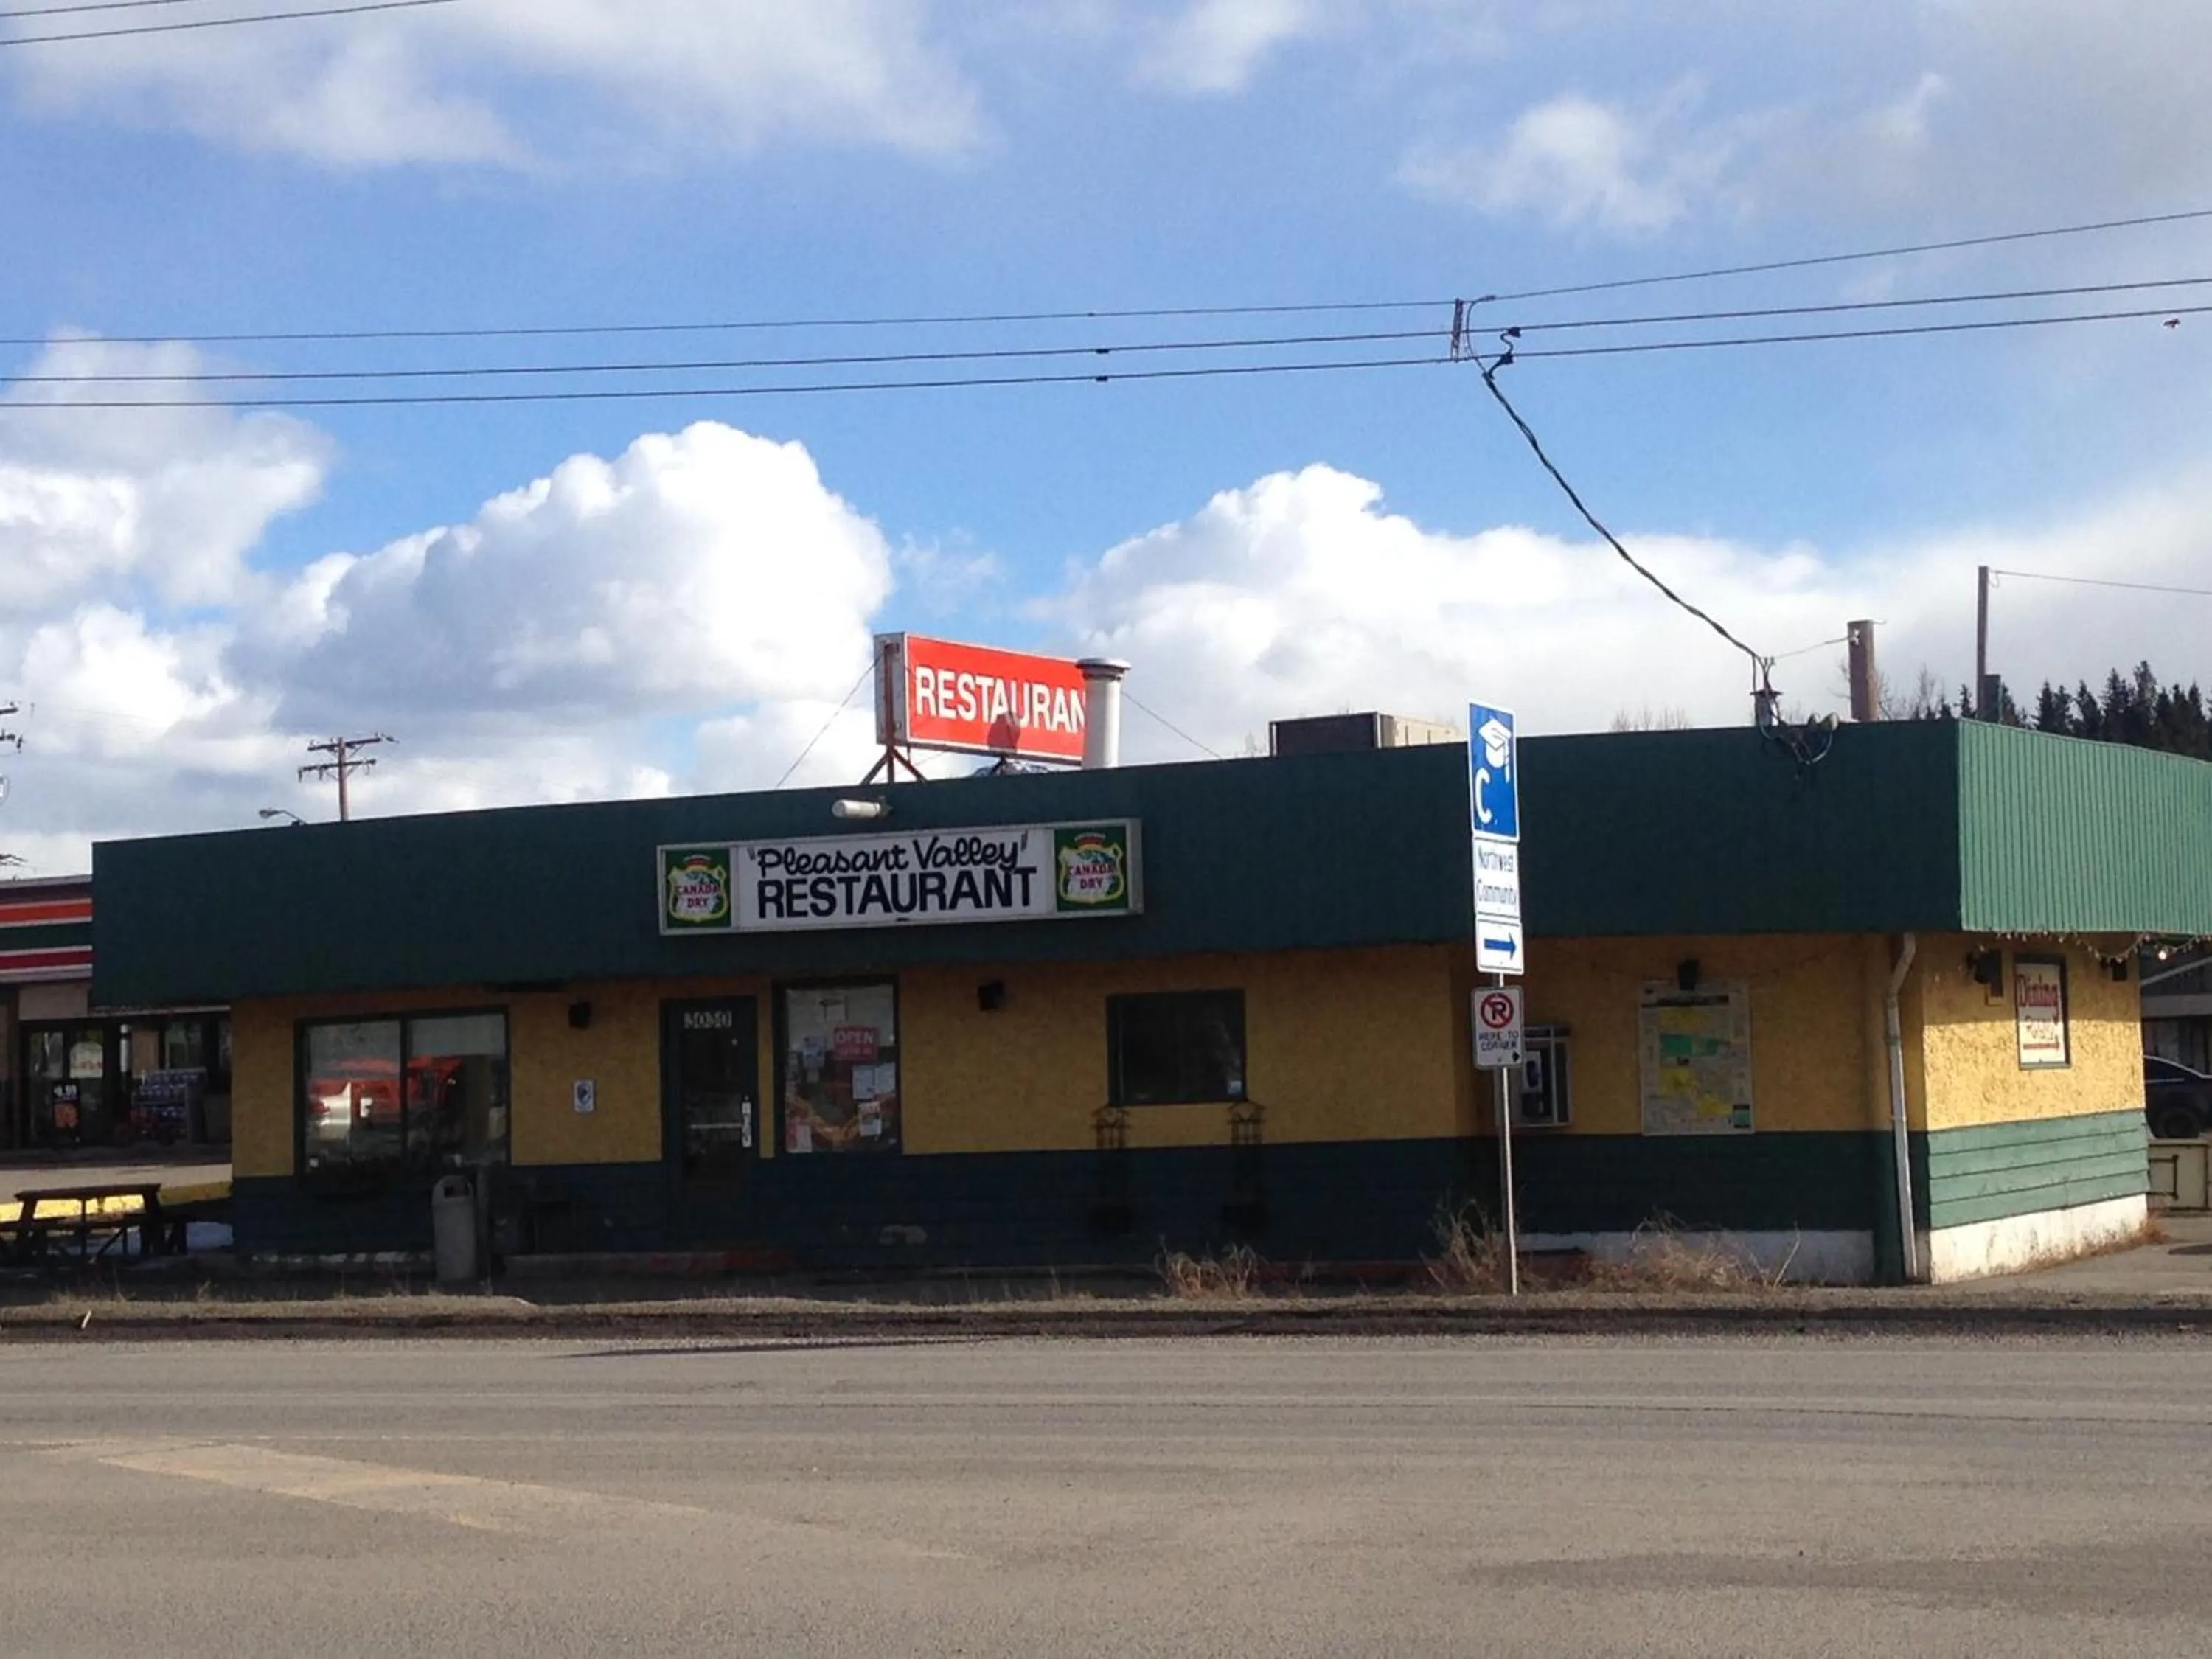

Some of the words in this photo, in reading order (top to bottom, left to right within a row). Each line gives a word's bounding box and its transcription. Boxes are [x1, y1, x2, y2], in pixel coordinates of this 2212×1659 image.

[1067, 863, 1116, 876] CANADA
[1079, 877, 1104, 889] DRY
[675, 884, 721, 896] CANADA
[757, 866, 1037, 919] RESTAURANT
[687, 897, 709, 908] DRY
[836, 1029, 874, 1045] OPEN
